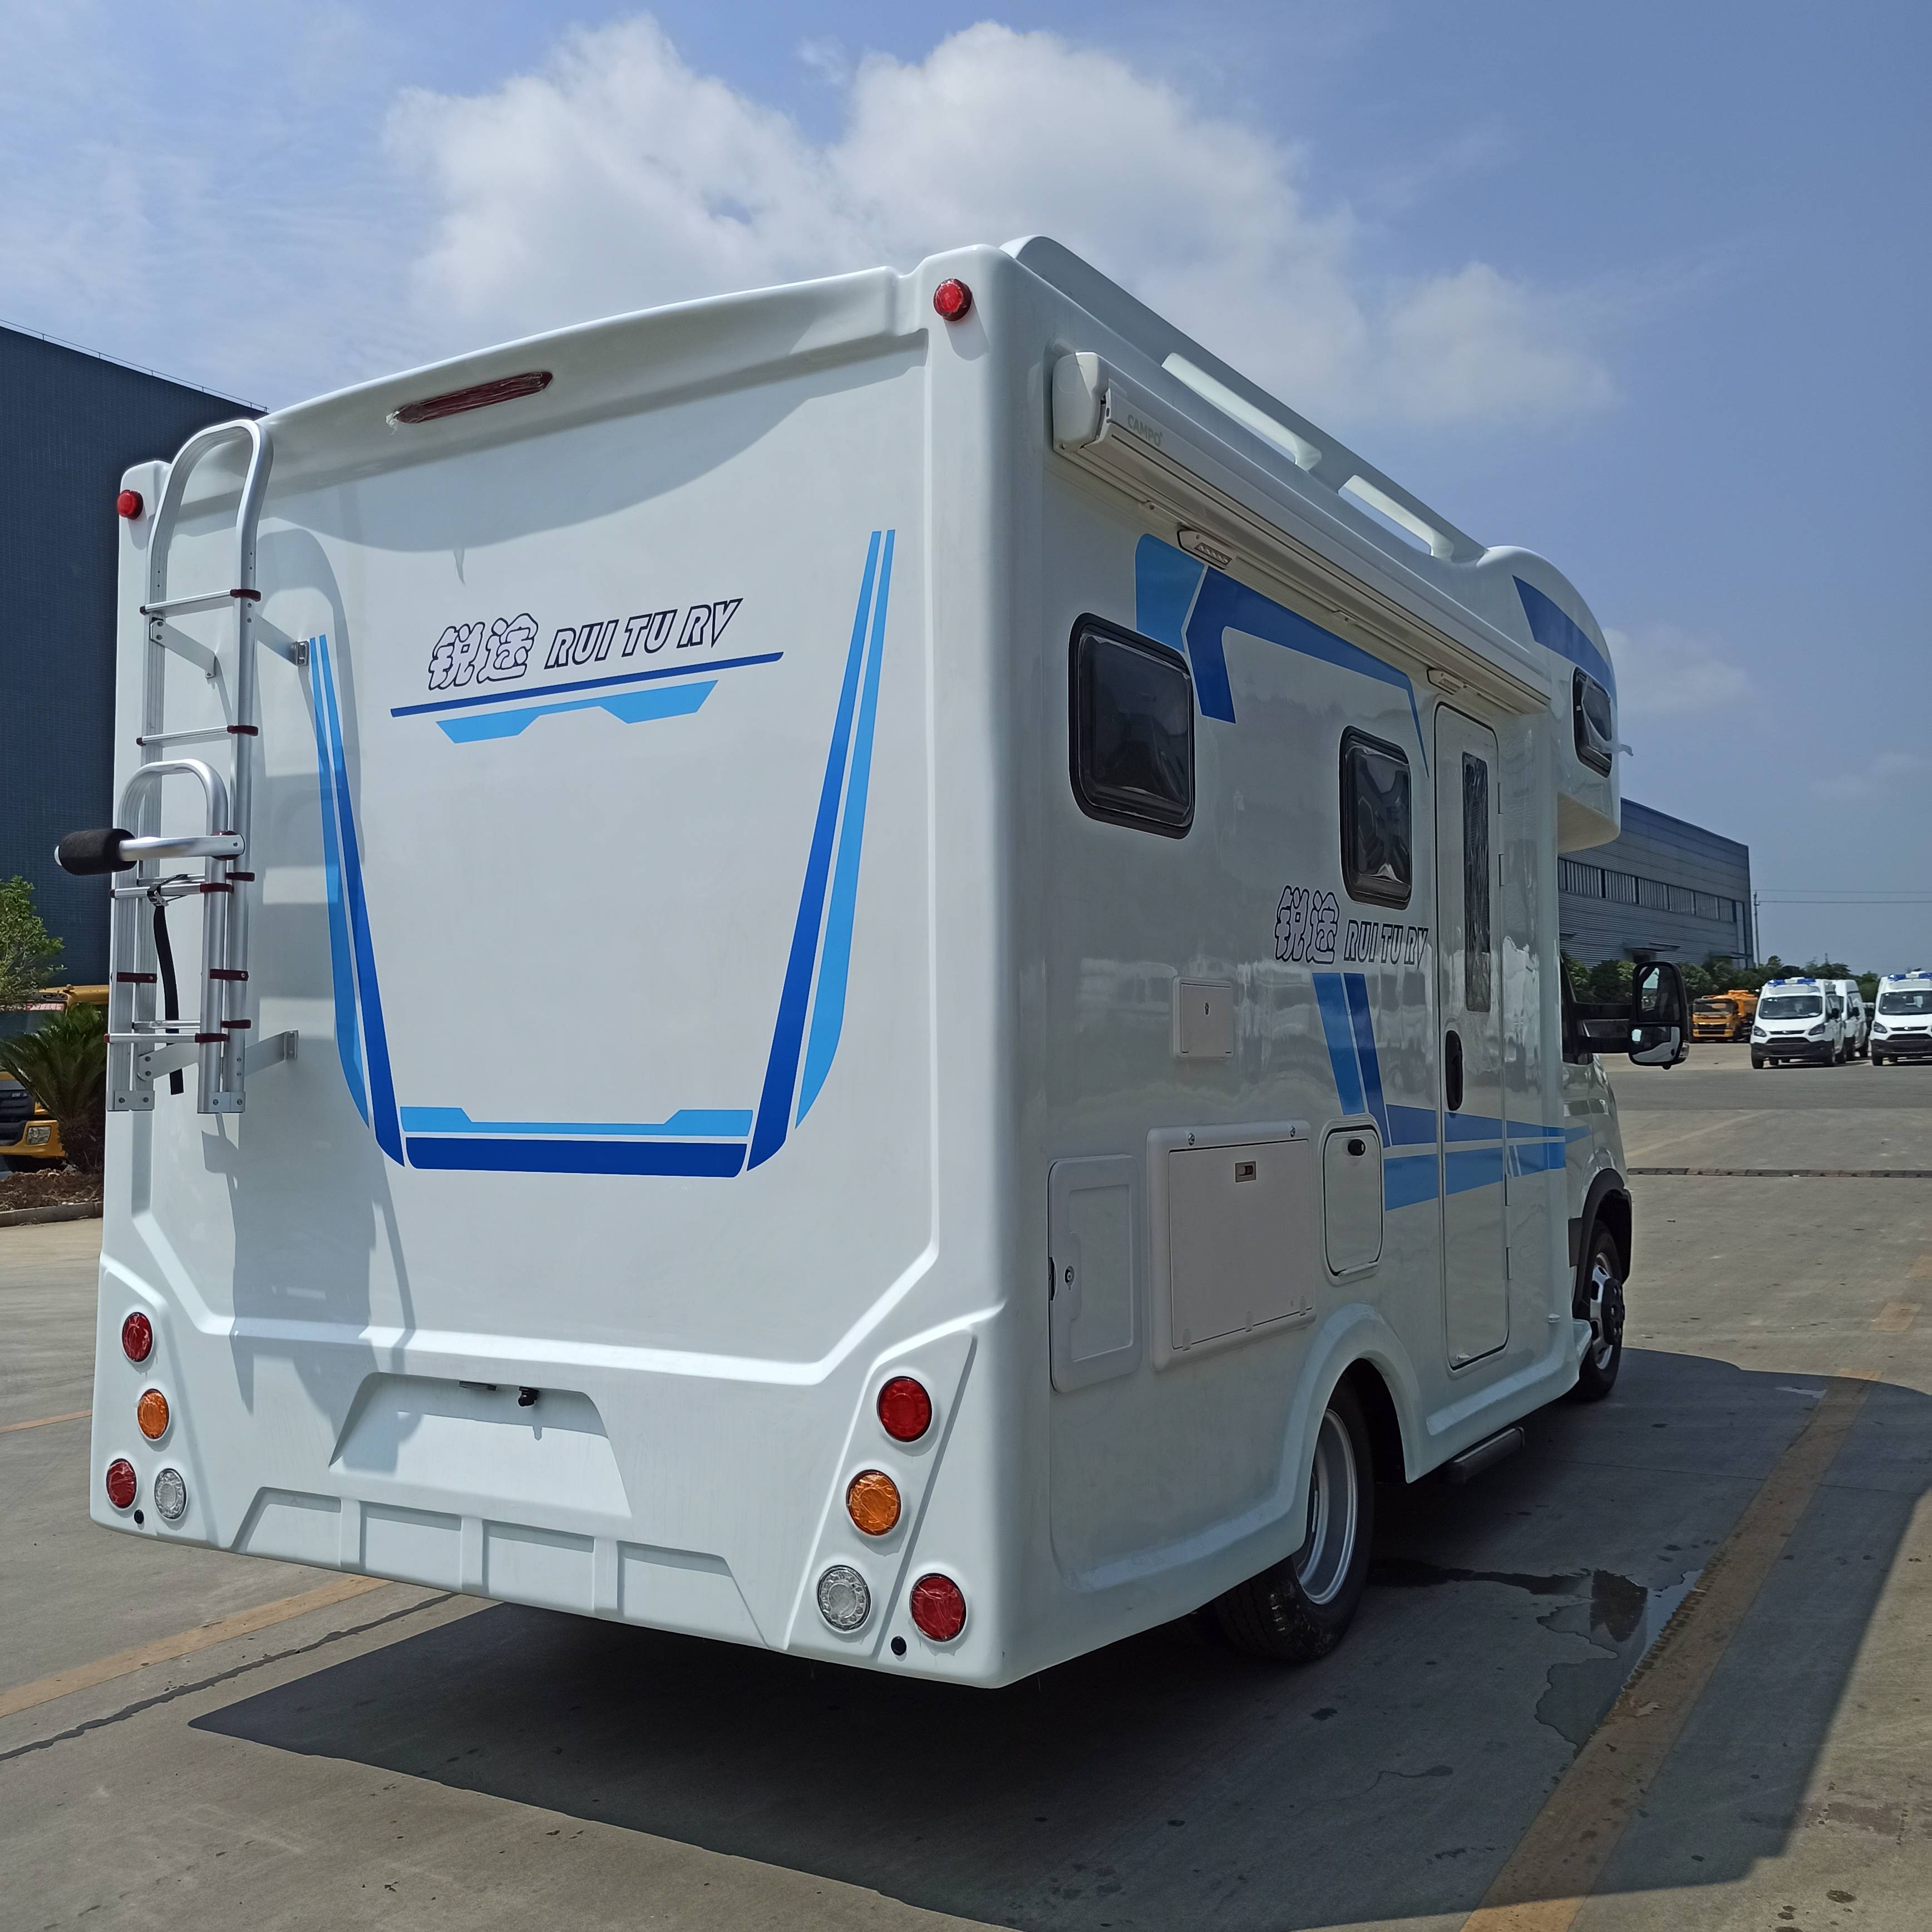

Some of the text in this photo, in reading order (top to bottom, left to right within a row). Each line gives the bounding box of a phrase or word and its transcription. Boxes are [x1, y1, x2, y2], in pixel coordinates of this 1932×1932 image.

[428, 598, 743, 691] 锐途 RUI TU RV
[1274, 885, 1429, 969] 锐途 RUI TU RV
